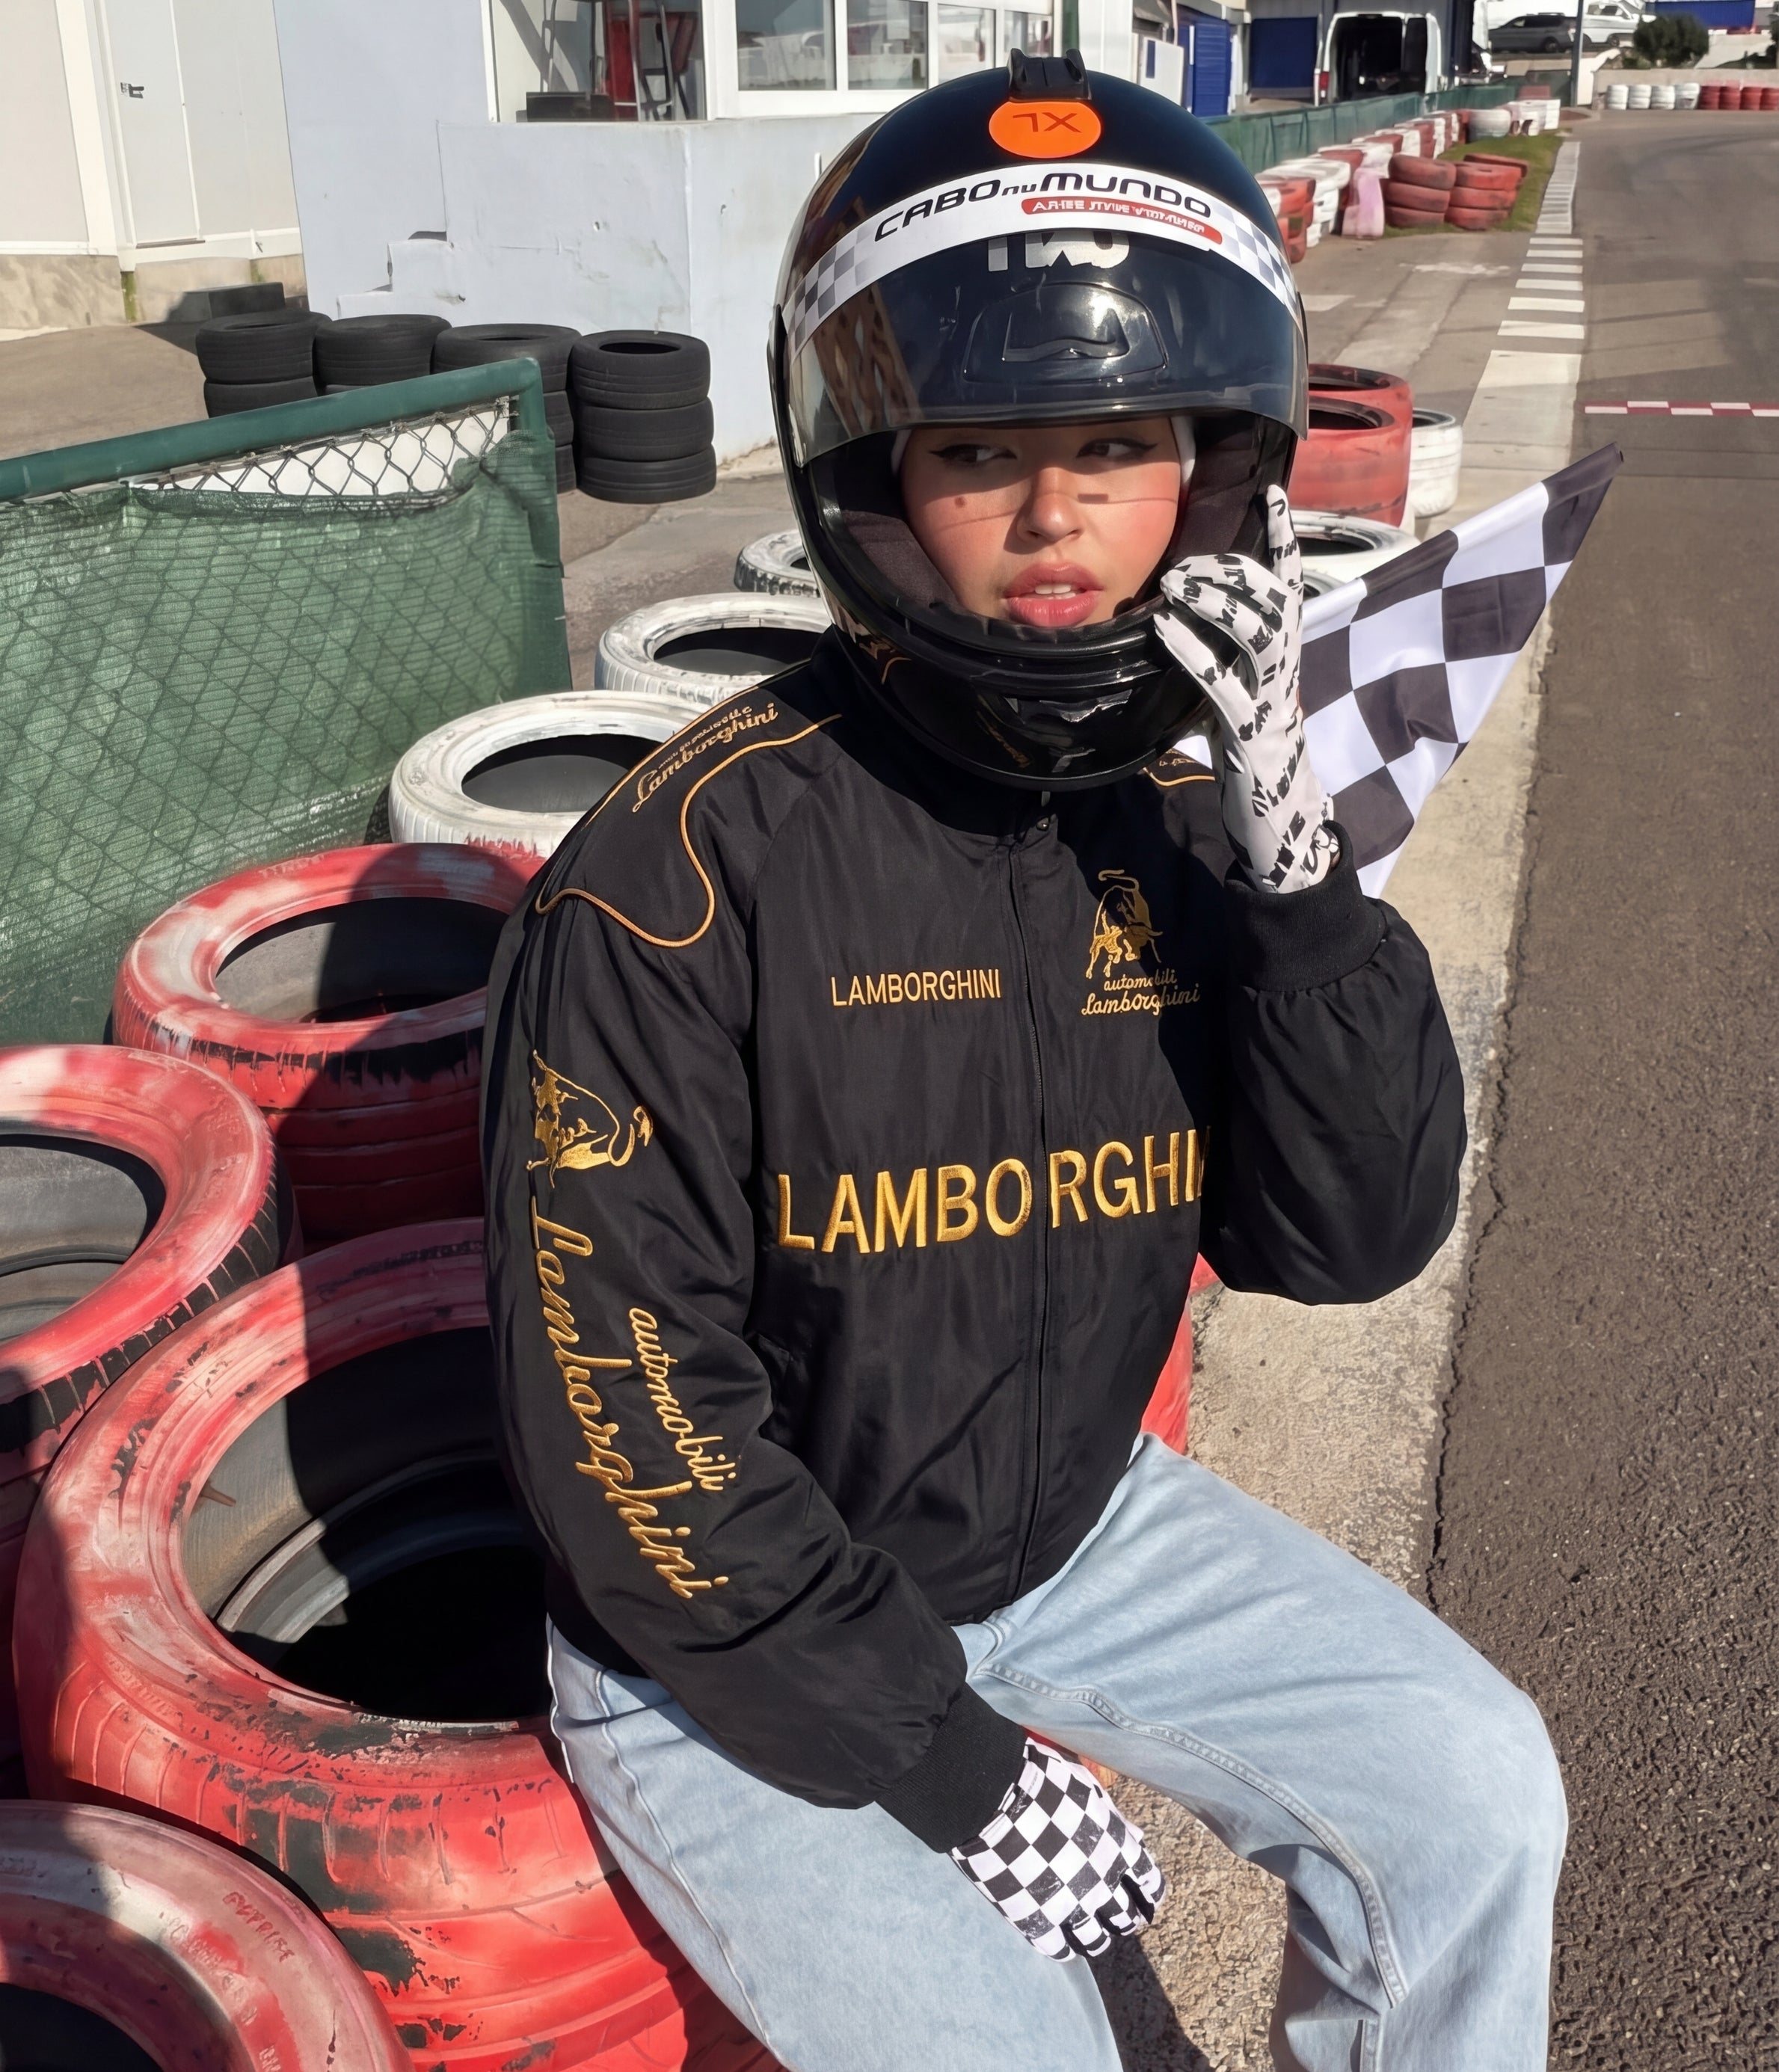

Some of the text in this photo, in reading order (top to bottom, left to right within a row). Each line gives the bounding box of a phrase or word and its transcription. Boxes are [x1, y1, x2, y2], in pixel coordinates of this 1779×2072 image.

[831, 968, 1001, 1006] LAMBORGHINI
[1081, 983, 1200, 1016] Lamborghini
[1103, 969, 1178, 992] automobili
[778, 1128, 1206, 1253] LAMBORGHI
[530, 1196, 730, 1599] Lamborghini
[628, 1307, 737, 1492] automobili
